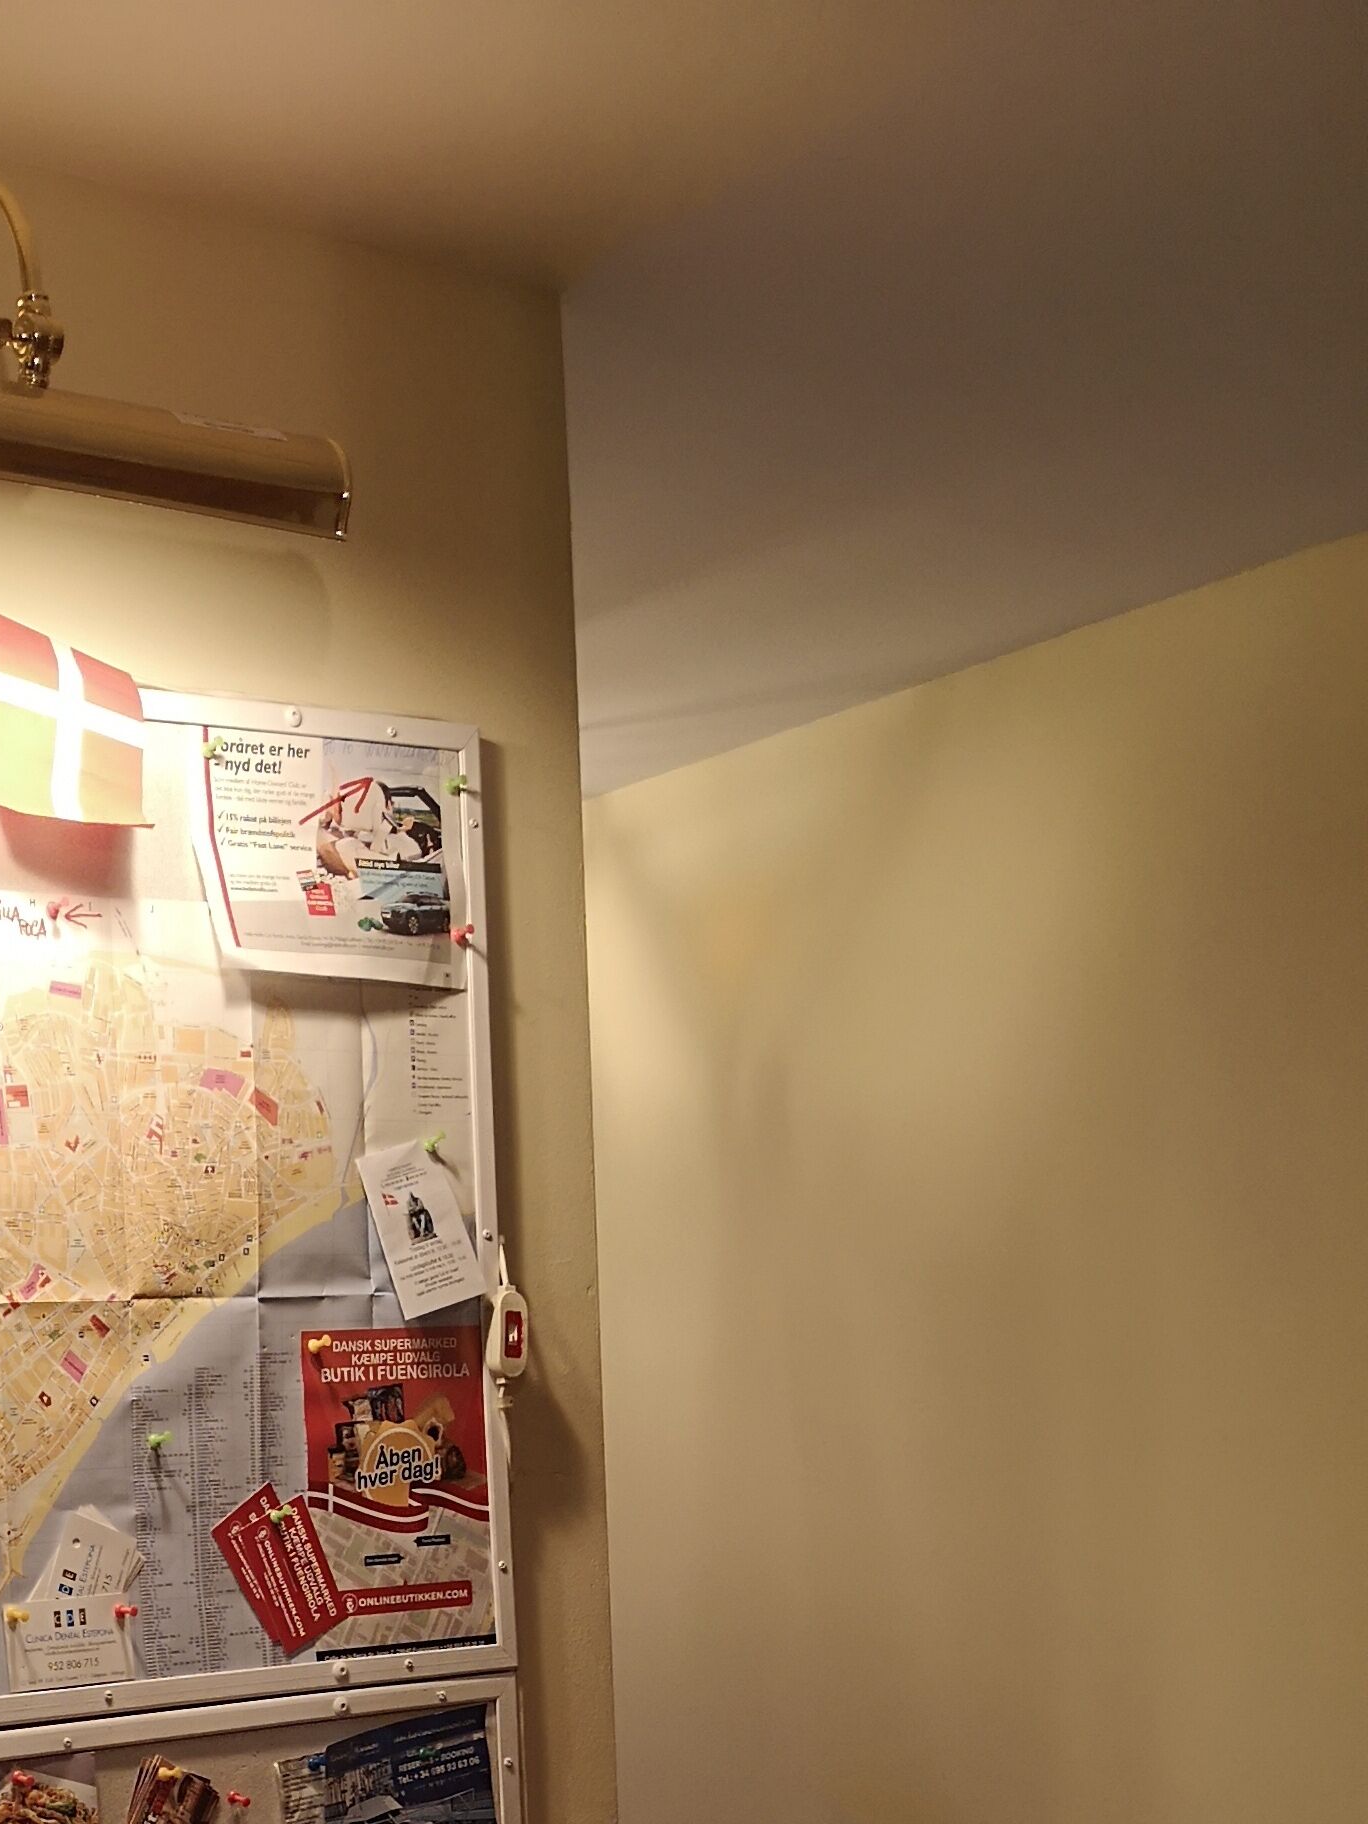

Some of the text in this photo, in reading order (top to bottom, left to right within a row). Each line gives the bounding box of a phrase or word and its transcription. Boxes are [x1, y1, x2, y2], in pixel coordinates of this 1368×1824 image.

[269, 744, 283, 757] er
[288, 744, 309, 759] her
[225, 758, 282, 774] nyd det!
[332, 1336, 458, 1352] DANSK SUPERMARKED
[351, 1350, 441, 1366] KÆMPE UDVALG
[321, 1363, 471, 1384] BUTIK FUENGIROLA
[375, 1445, 423, 1470] Åben
[355, 1456, 442, 1491] hver dag!
[291, 1507, 338, 1617] DANSK SUPERMARKED
[292, 1556, 322, 1621] FUENGIROLA
[304, 1565, 324, 1606] UDVALG
[358, 1588, 469, 1608] ONLINEBUTIKKEN.COM
[82, 1628, 114, 1639] ESTEPONA
[48, 1660, 65, 1671] 952
[83, 1657, 100, 1667] 715
